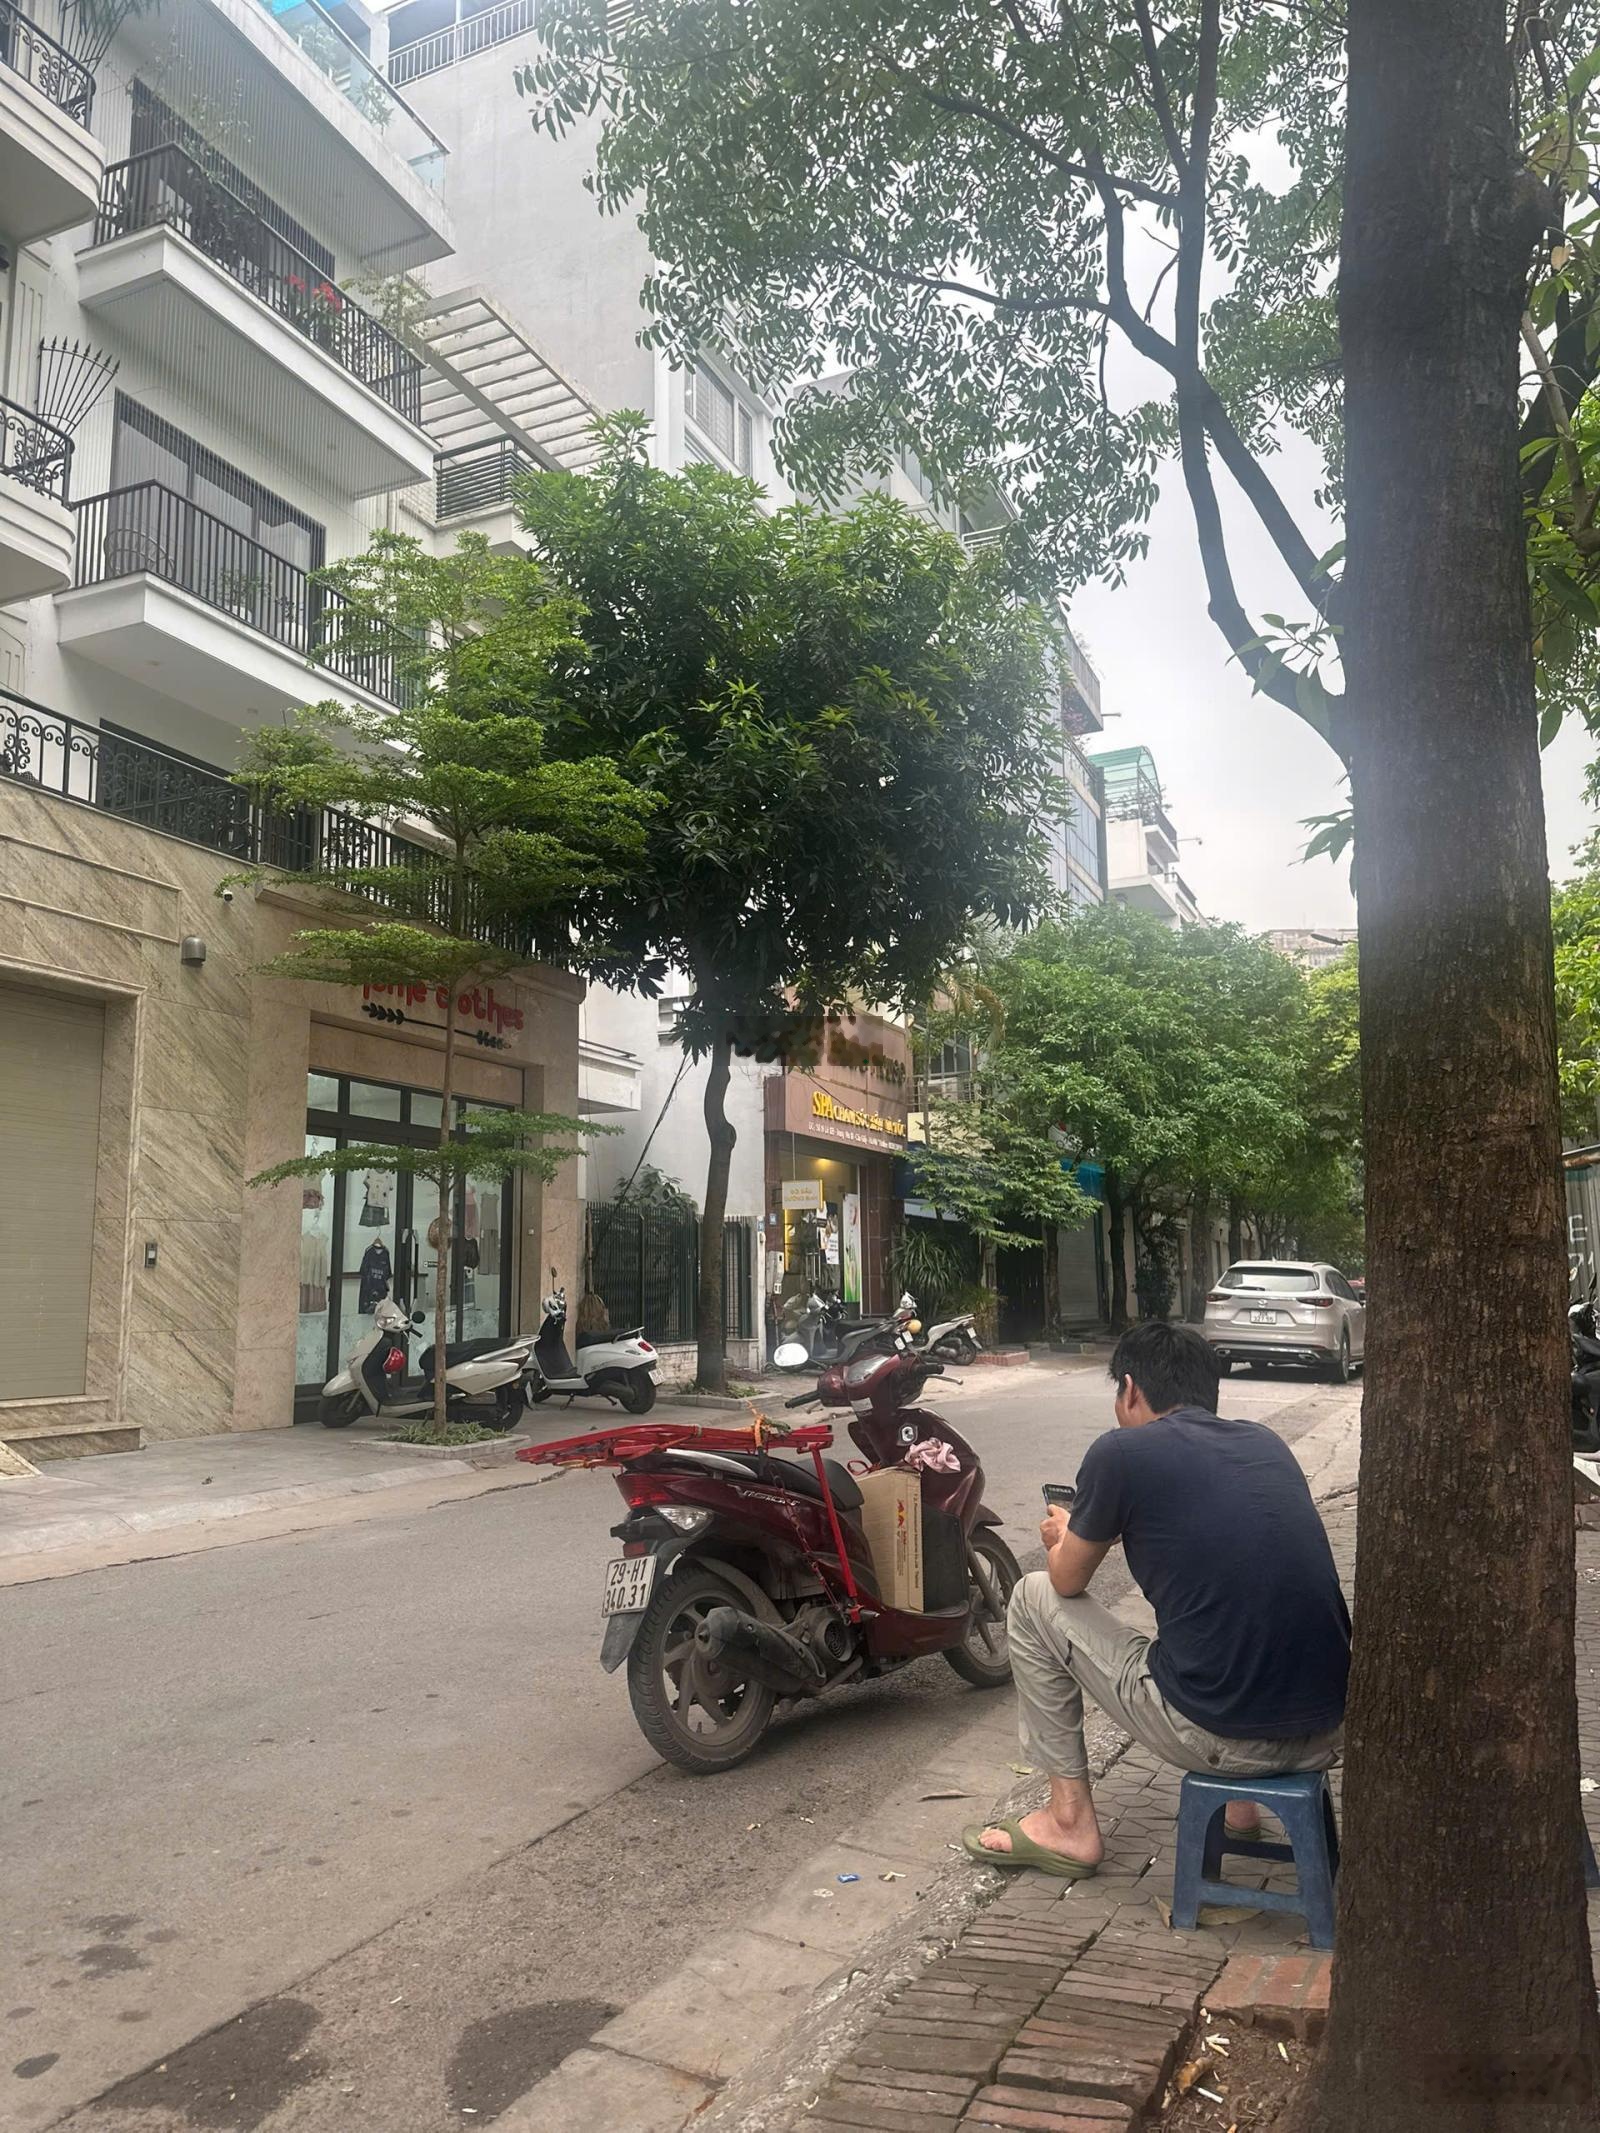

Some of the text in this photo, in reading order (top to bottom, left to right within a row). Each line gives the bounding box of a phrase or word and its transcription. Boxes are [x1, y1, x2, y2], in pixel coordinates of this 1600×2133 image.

[435, 986, 524, 1034] cothes
[812, 1090, 834, 1120] SPA
[604, 1583, 647, 1613] 340.31
